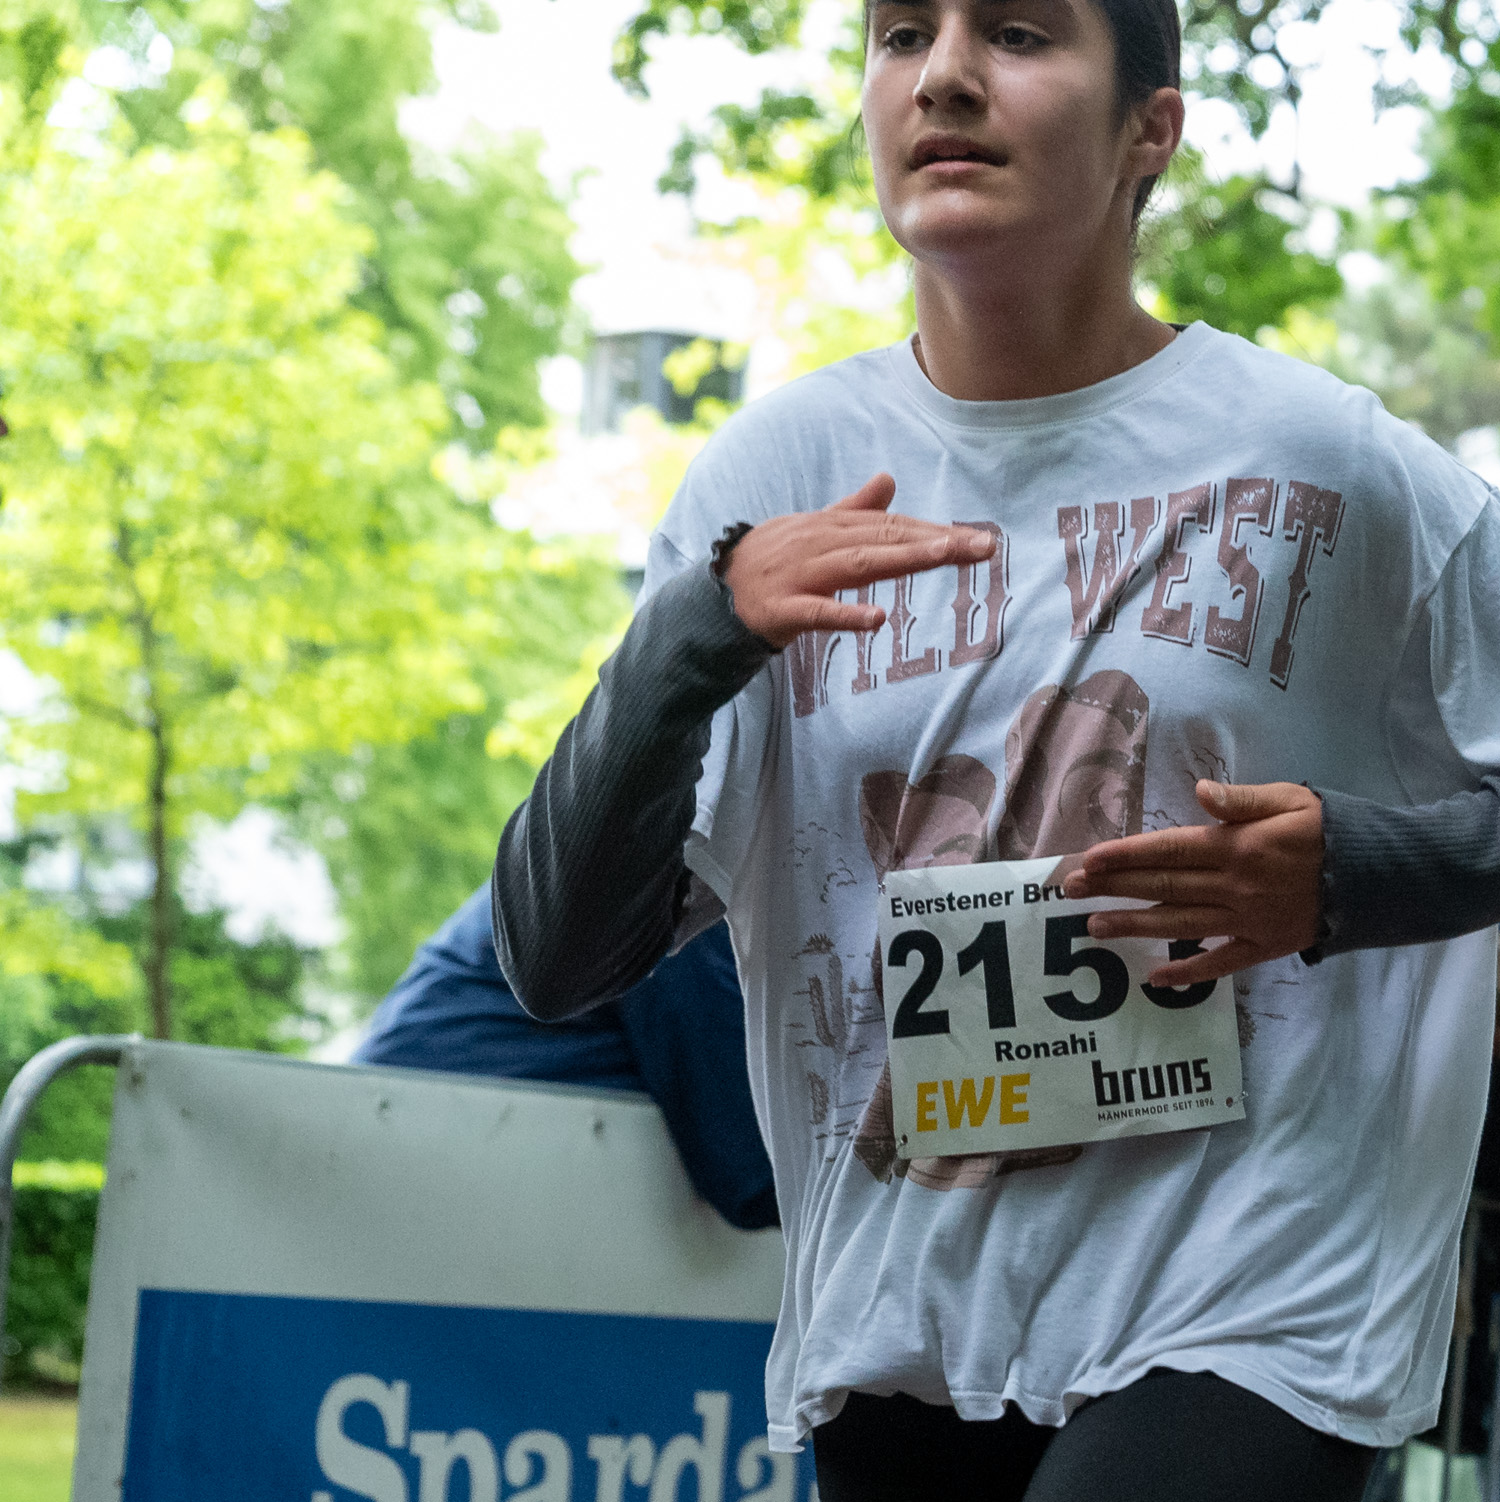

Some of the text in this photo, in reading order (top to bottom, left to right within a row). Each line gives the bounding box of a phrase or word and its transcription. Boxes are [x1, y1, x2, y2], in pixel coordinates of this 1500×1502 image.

[1057, 478, 1346, 692] WEST
[891, 890, 1015, 918] Everstener
[994, 1031, 1098, 1062] Ronahi
[1091, 1058, 1213, 1107] bruns
[915, 1073, 1031, 1133] EWE
[1097, 1103, 1170, 1121] MÄNNERMODE
[1173, 1100, 1193, 1112] SEIT
